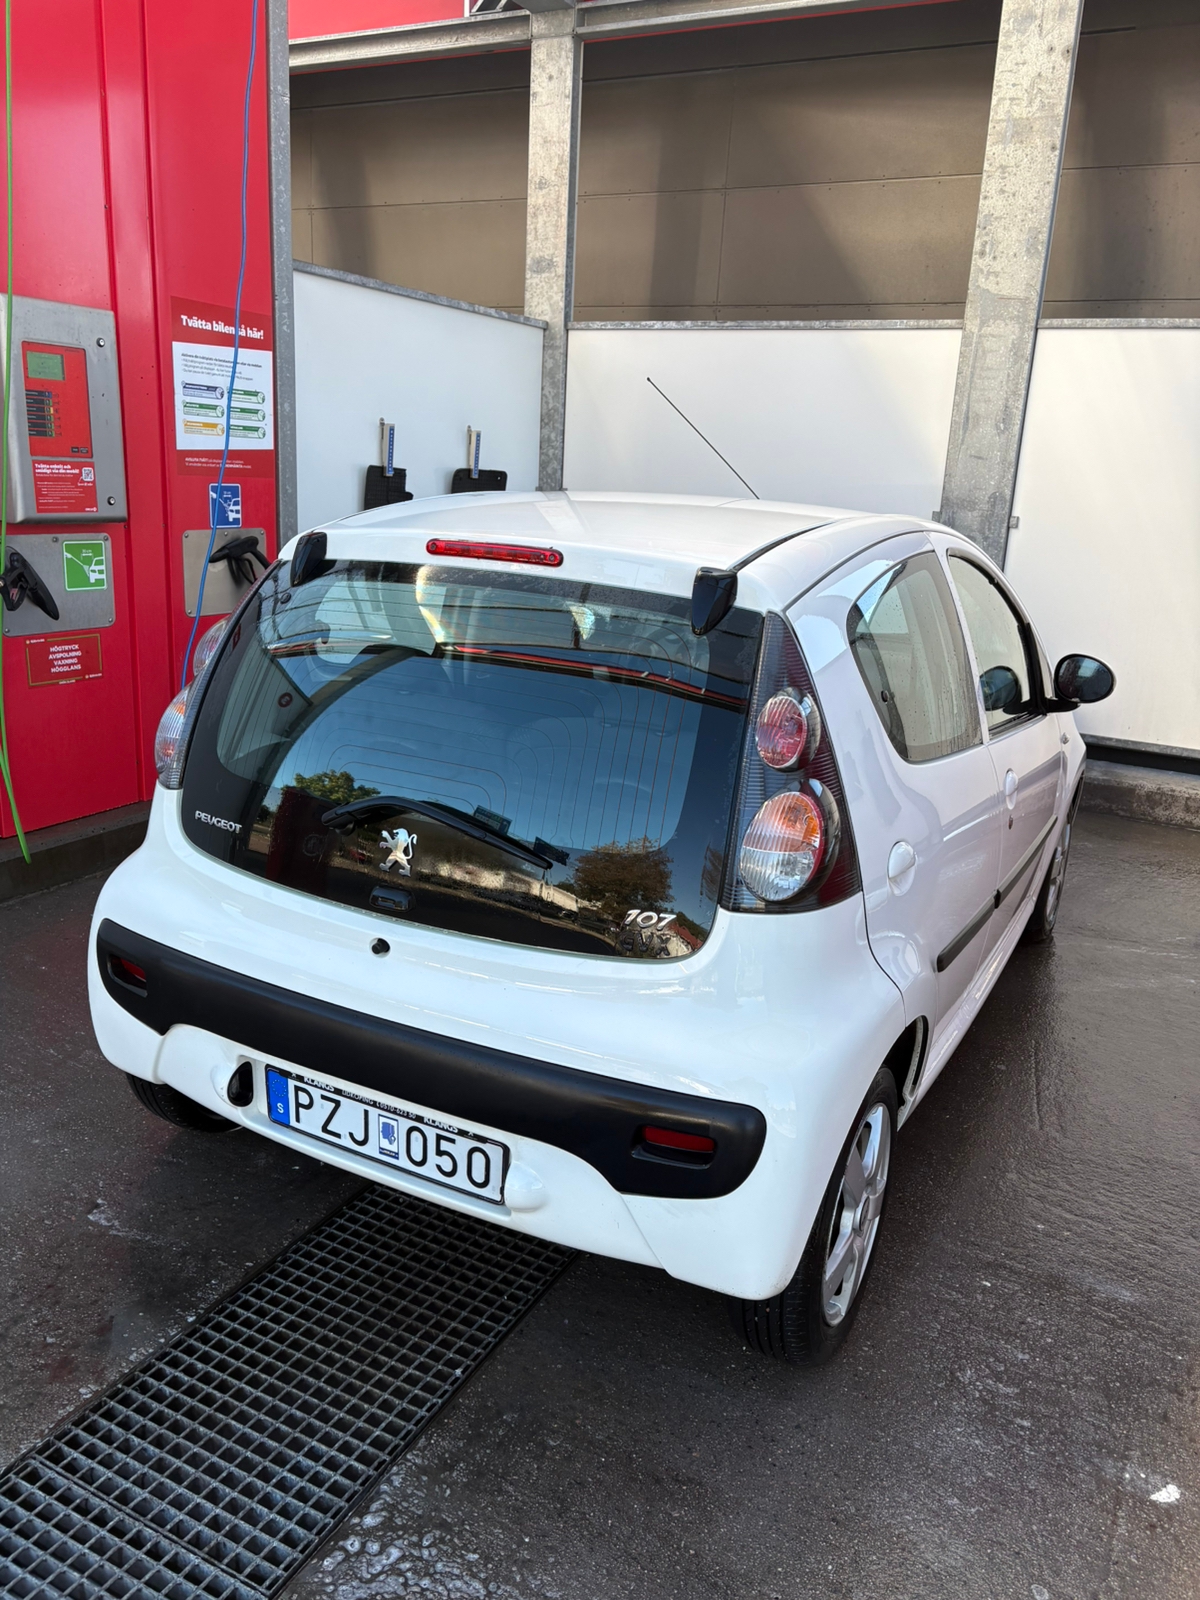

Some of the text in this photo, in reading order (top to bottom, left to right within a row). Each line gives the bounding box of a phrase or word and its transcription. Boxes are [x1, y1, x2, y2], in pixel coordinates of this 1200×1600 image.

[180, 315, 212, 331] Tvätta
[213, 321, 235, 335] bilen
[247, 327, 264, 339] här!
[48, 650, 82, 660] AVSPOLNING
[50, 644, 79, 652] HÖGTRYCK
[50, 664, 82, 673] HÖGGLANS
[194, 810, 242, 834] PEUGEOT
[624, 909, 677, 931] 107
[277, 1102, 284, 1114] S
[303, 1075, 335, 1092] KLANGS
[423, 1116, 459, 1134] KLANGS
[294, 1084, 491, 1189] PZJ 050
